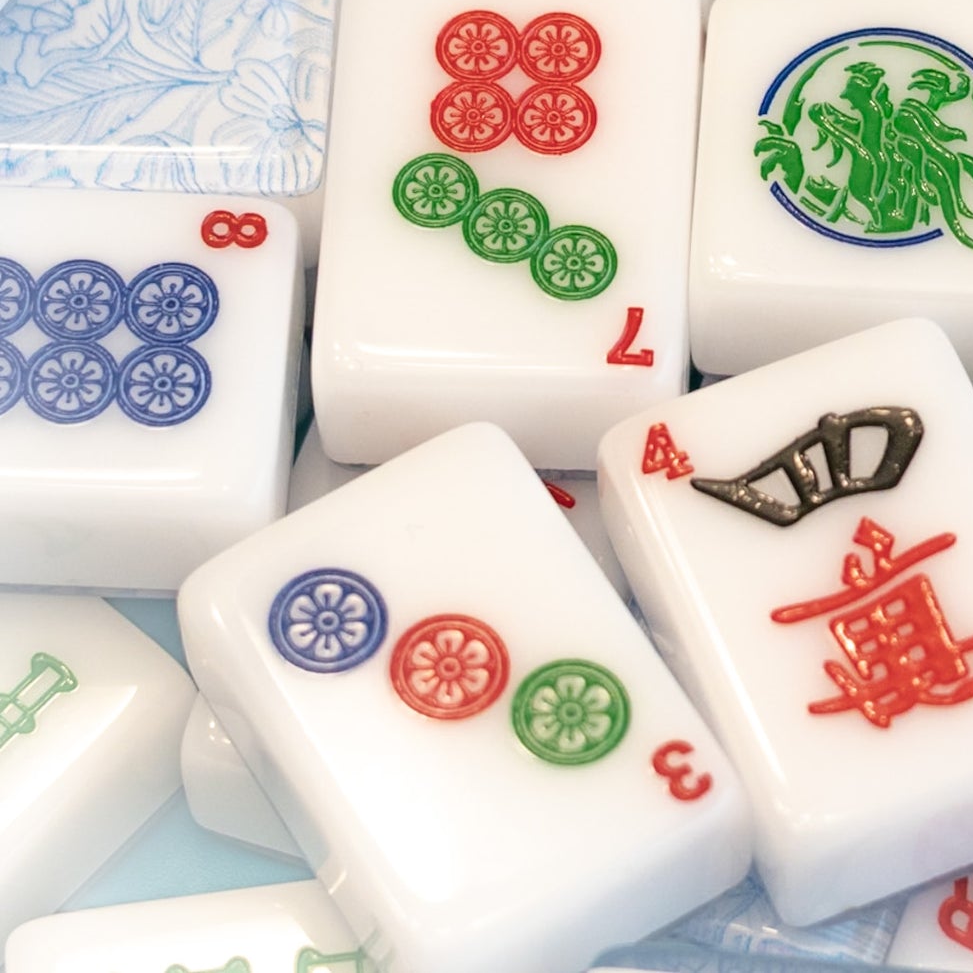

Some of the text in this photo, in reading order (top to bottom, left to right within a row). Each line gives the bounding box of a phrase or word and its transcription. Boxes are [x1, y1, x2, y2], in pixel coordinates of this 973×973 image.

[200, 208, 269, 251] 8
[605, 305, 655, 369] 7
[640, 420, 696, 483] 4
[650, 738, 714, 804] 3
